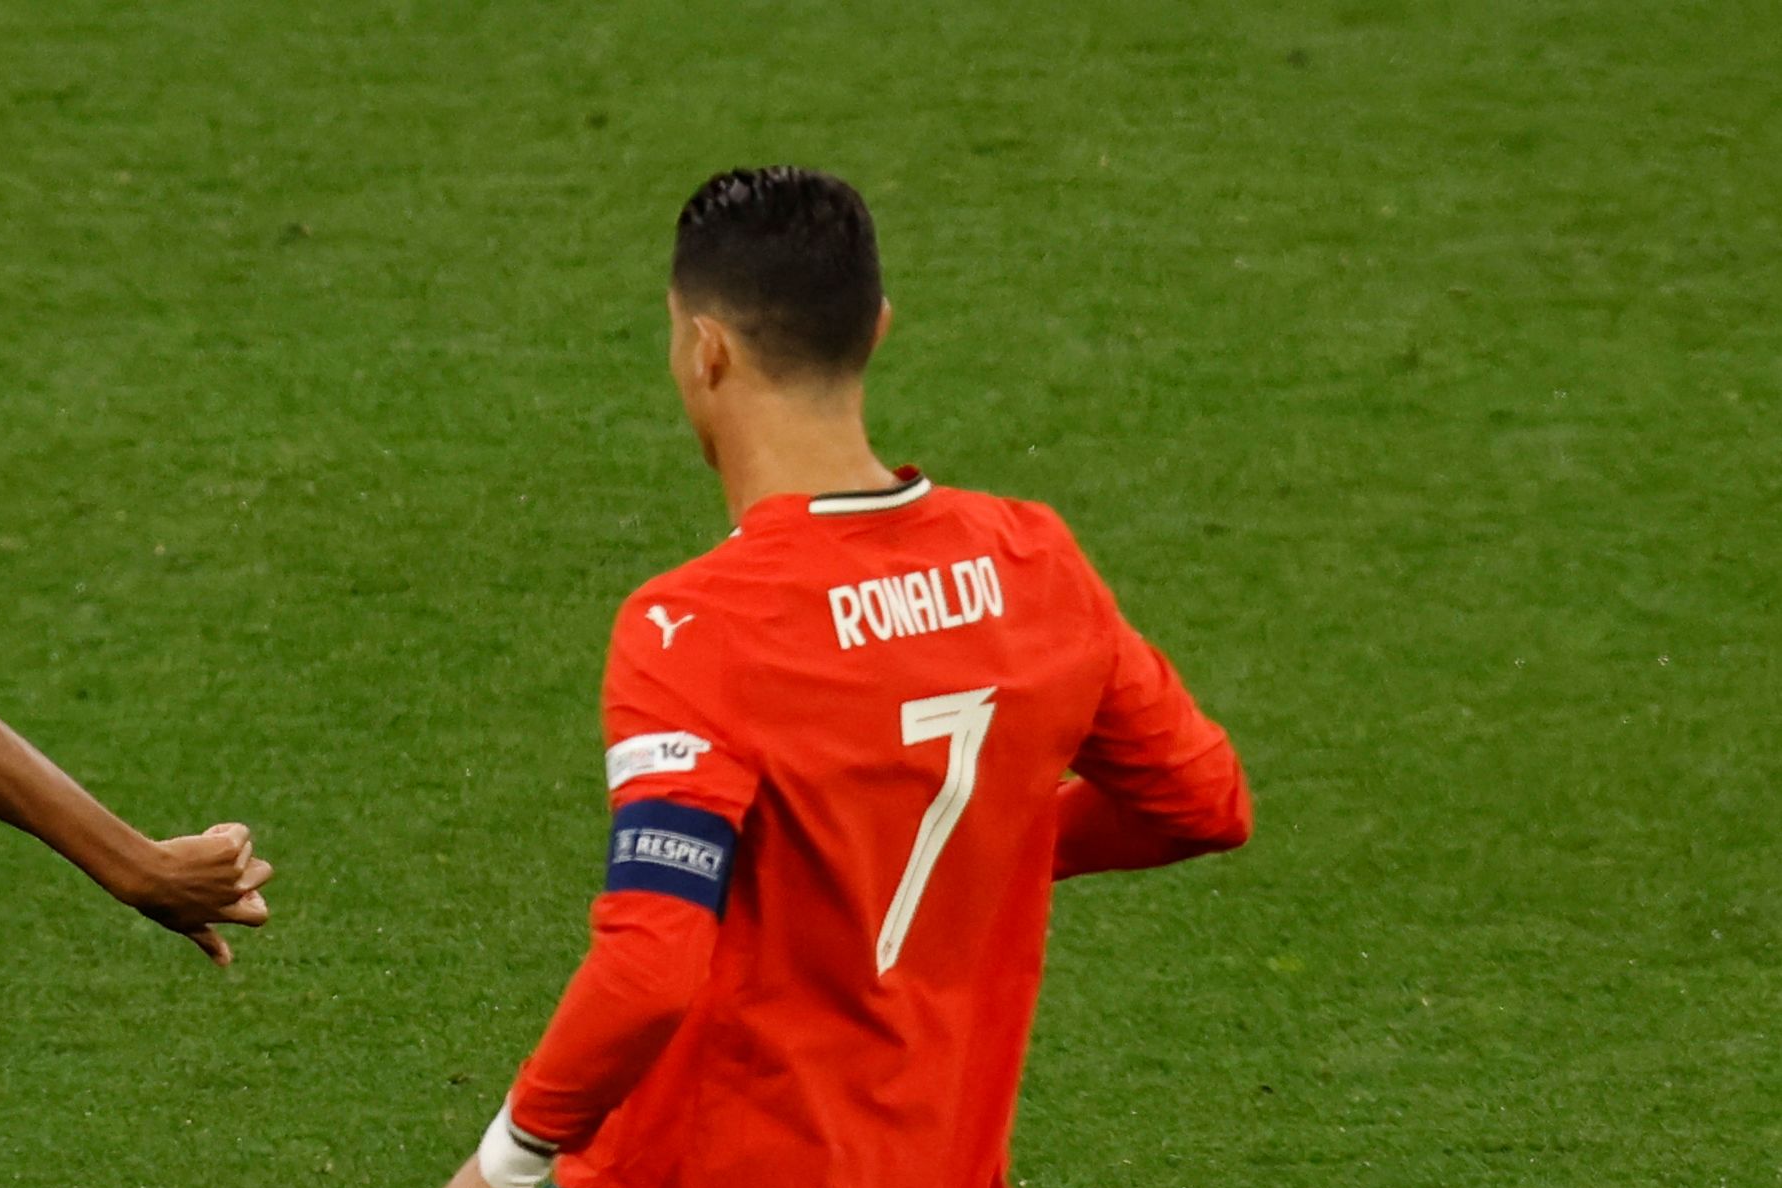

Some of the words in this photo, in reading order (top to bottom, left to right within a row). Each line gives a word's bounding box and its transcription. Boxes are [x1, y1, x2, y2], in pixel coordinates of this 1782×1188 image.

[827, 555, 1005, 650] RONALDO
[636, 834, 721, 871] RESPECT
[876, 685, 999, 977] 7
